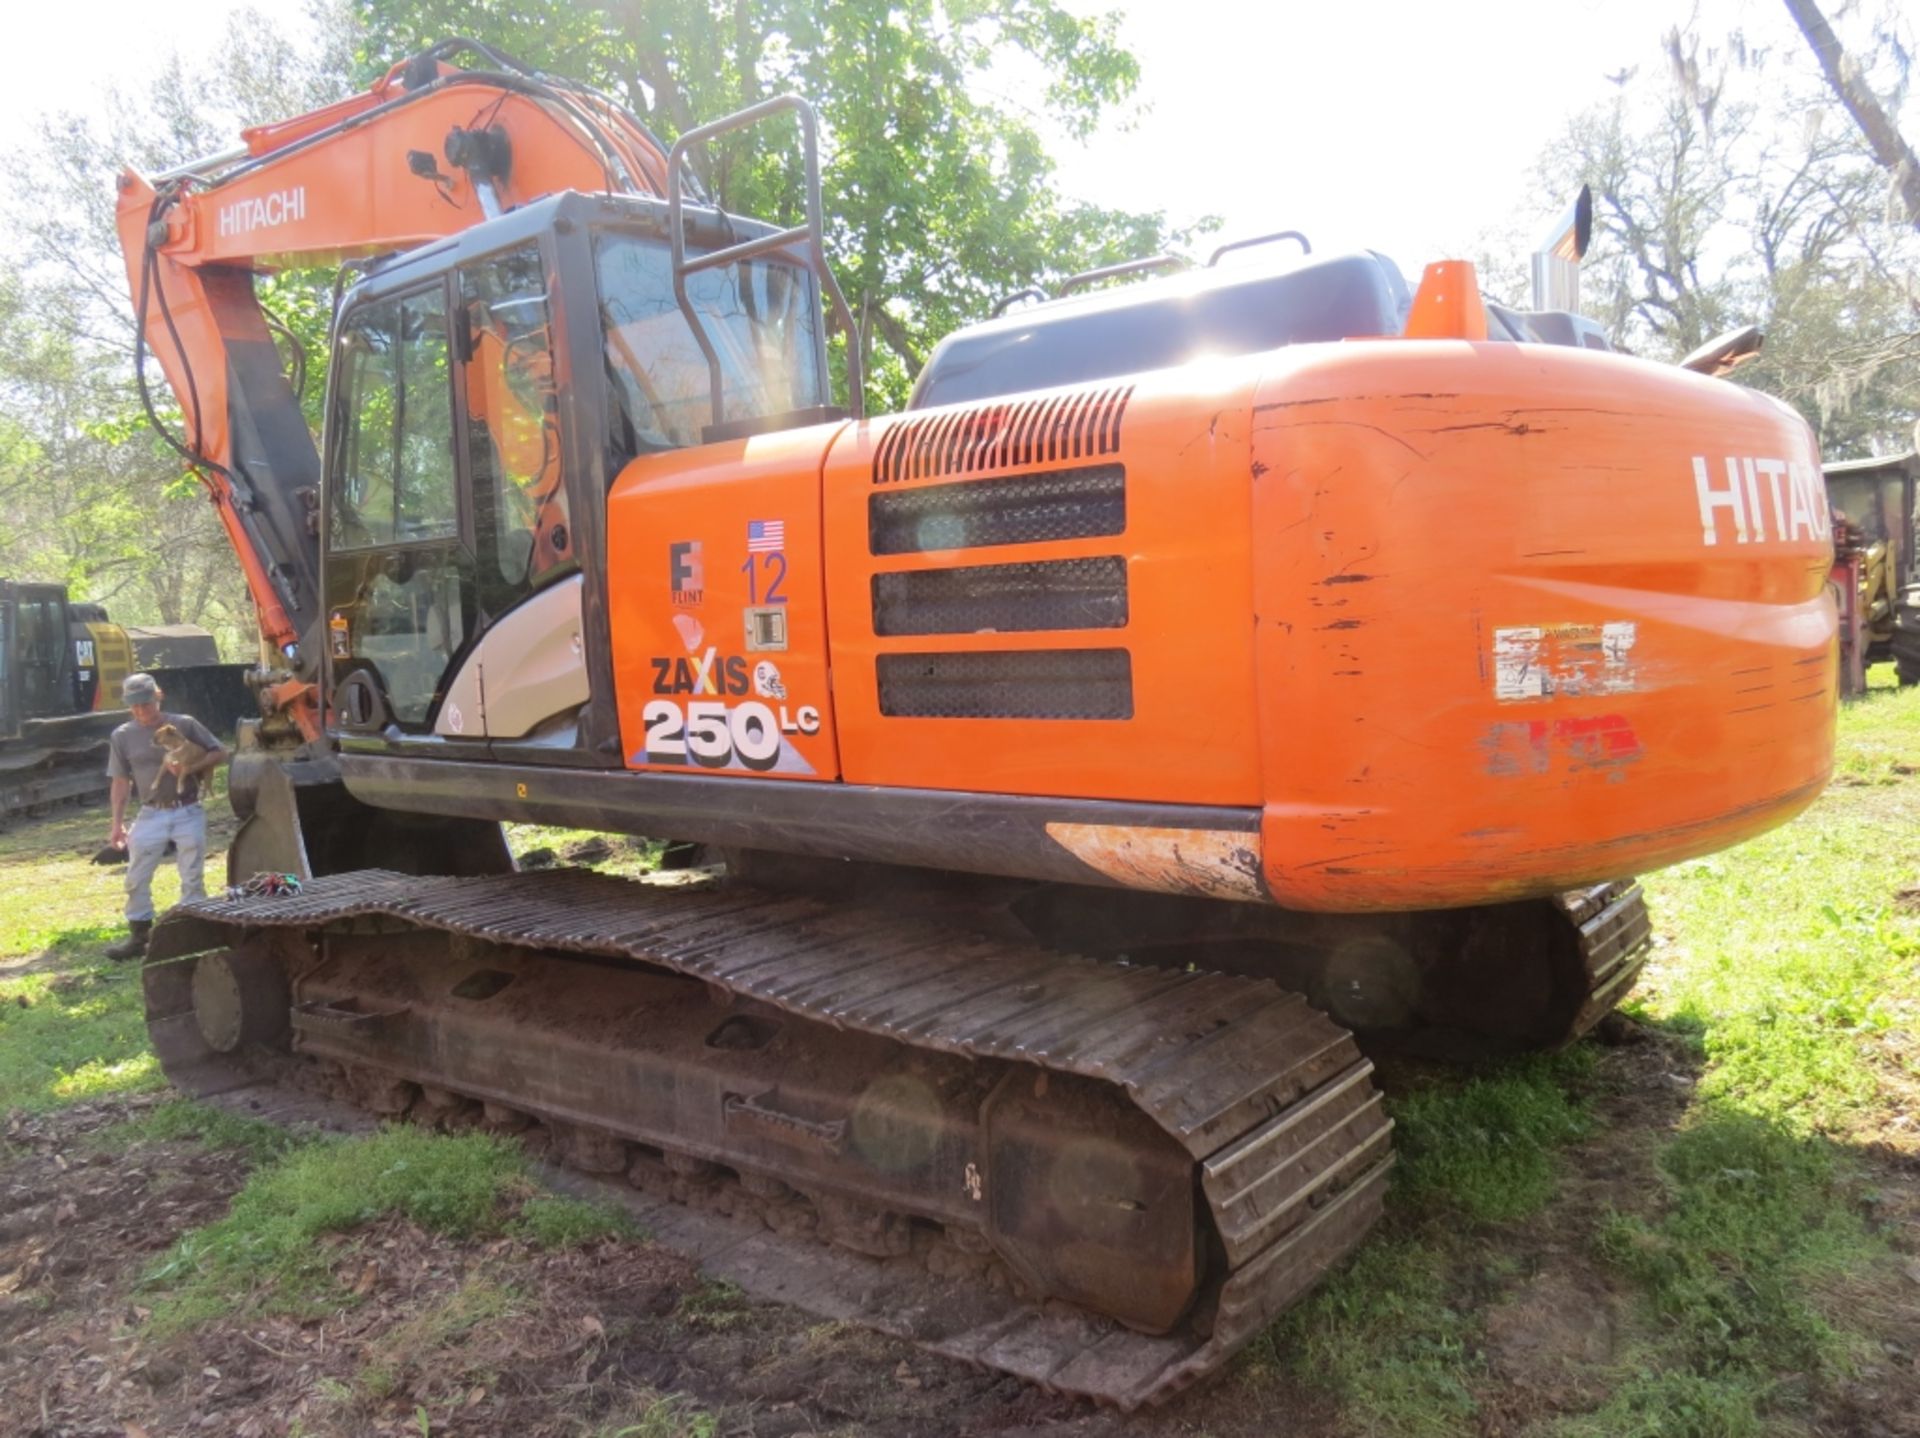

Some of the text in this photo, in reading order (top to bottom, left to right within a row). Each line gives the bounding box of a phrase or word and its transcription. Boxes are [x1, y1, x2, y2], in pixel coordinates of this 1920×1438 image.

[220, 186, 305, 236] HITACHI
[672, 589, 704, 604] FLINT
[741, 551, 788, 605] 12
[651, 646, 749, 696] ZAXIS
[642, 699, 781, 771] 250
